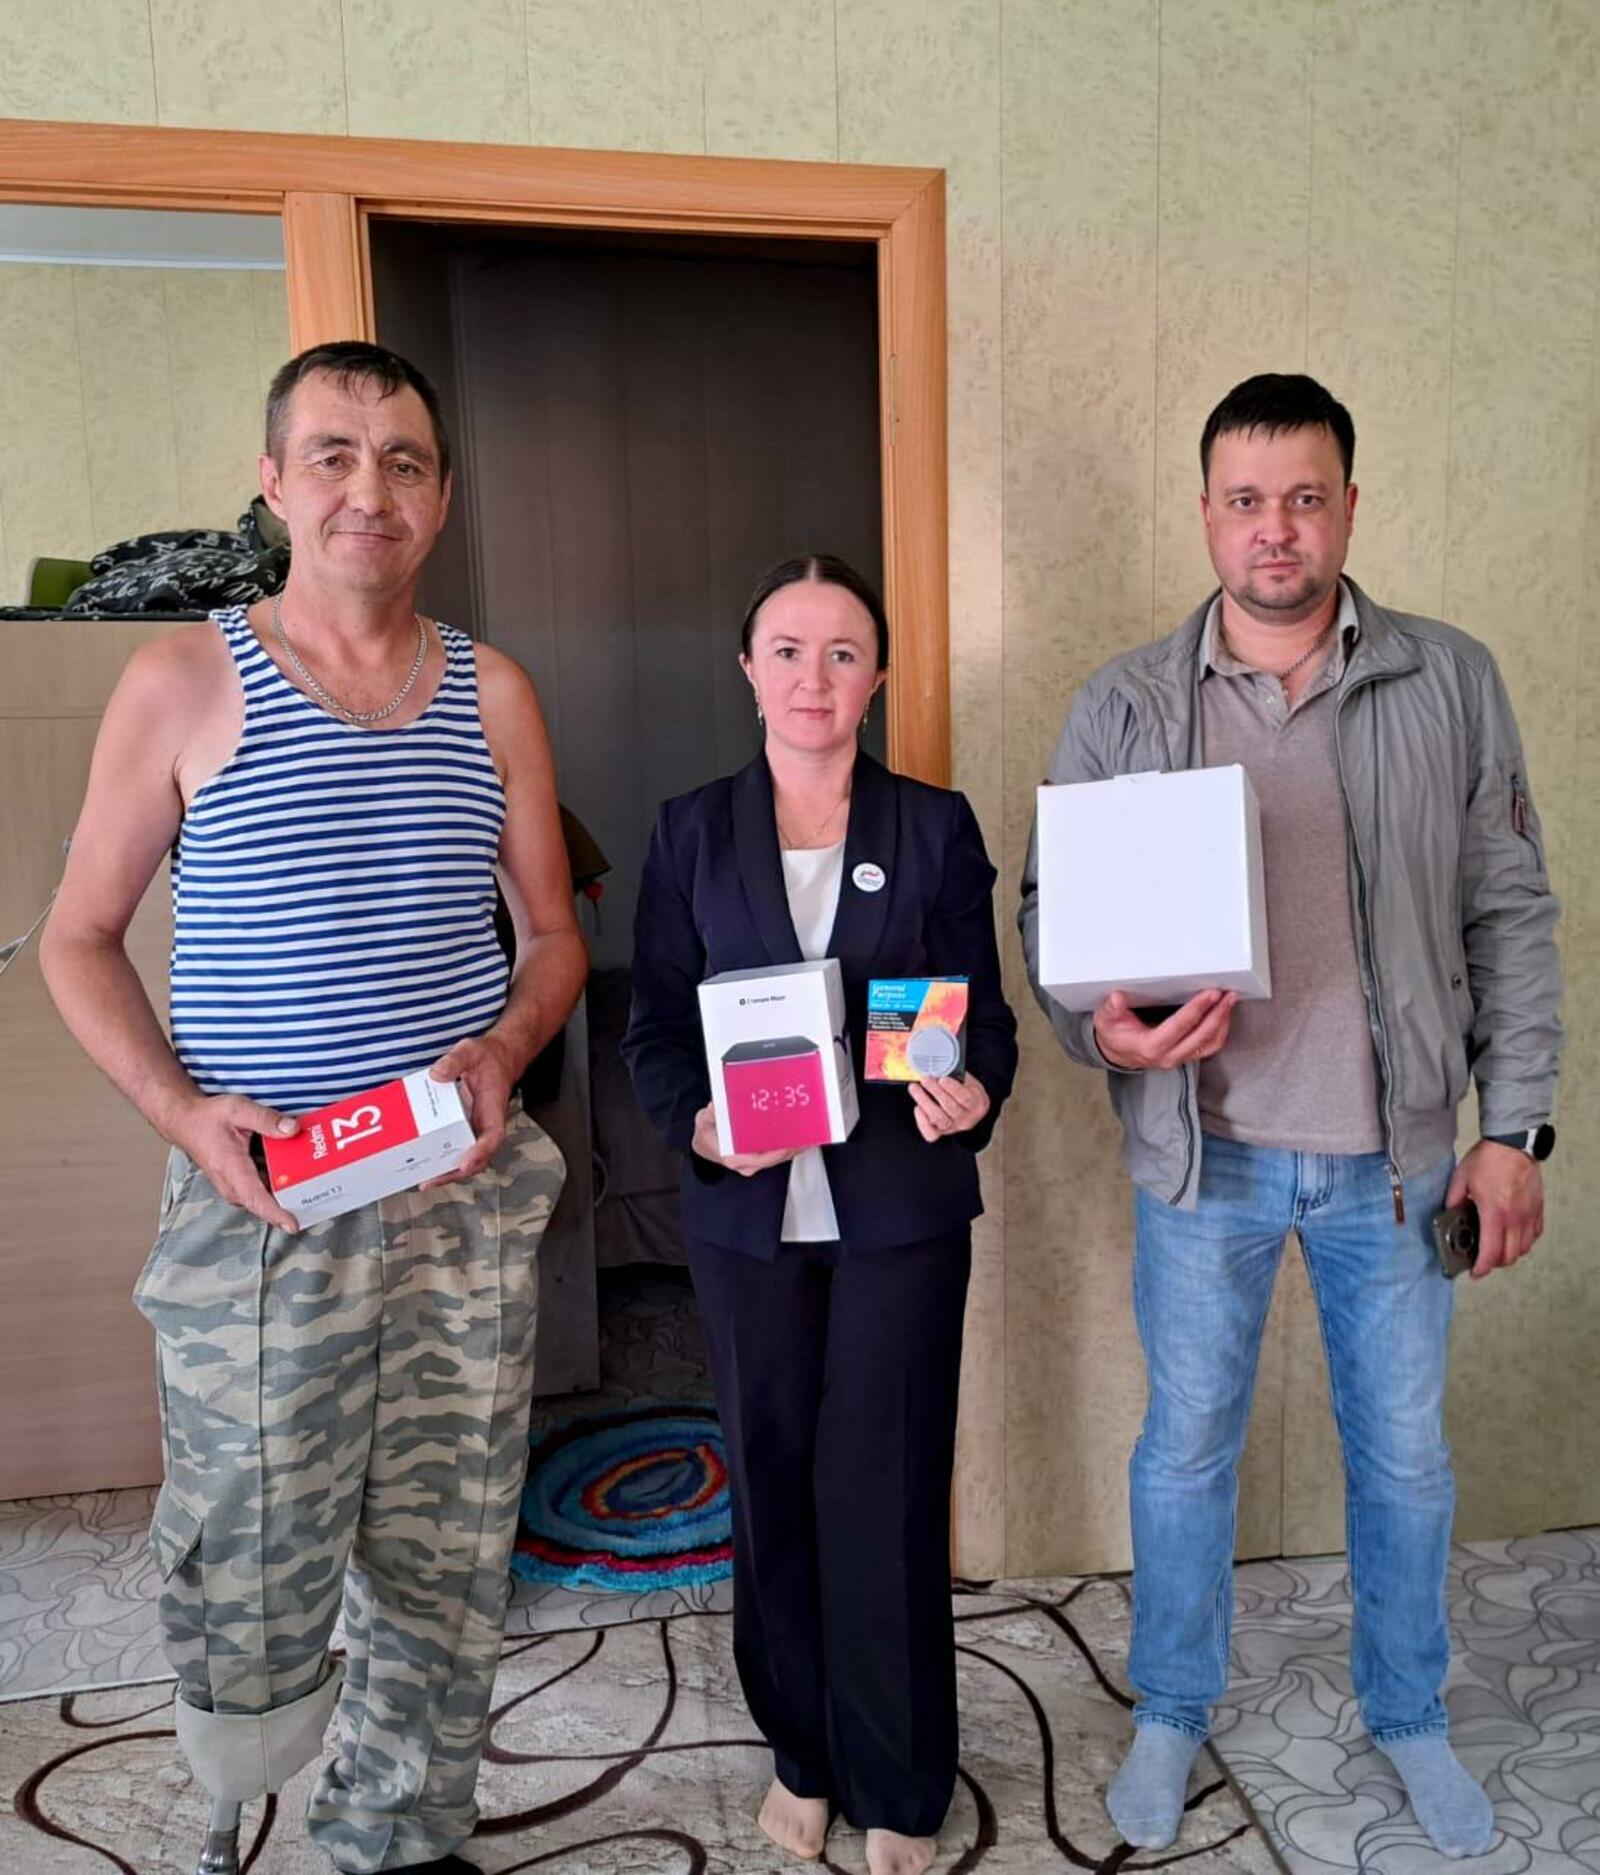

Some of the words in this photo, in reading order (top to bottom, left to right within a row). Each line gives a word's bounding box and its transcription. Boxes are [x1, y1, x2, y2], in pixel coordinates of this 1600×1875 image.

[751, 1084, 810, 1111] 12:35
[308, 1123, 328, 1160] Redmi
[331, 1105, 383, 1150] 13
